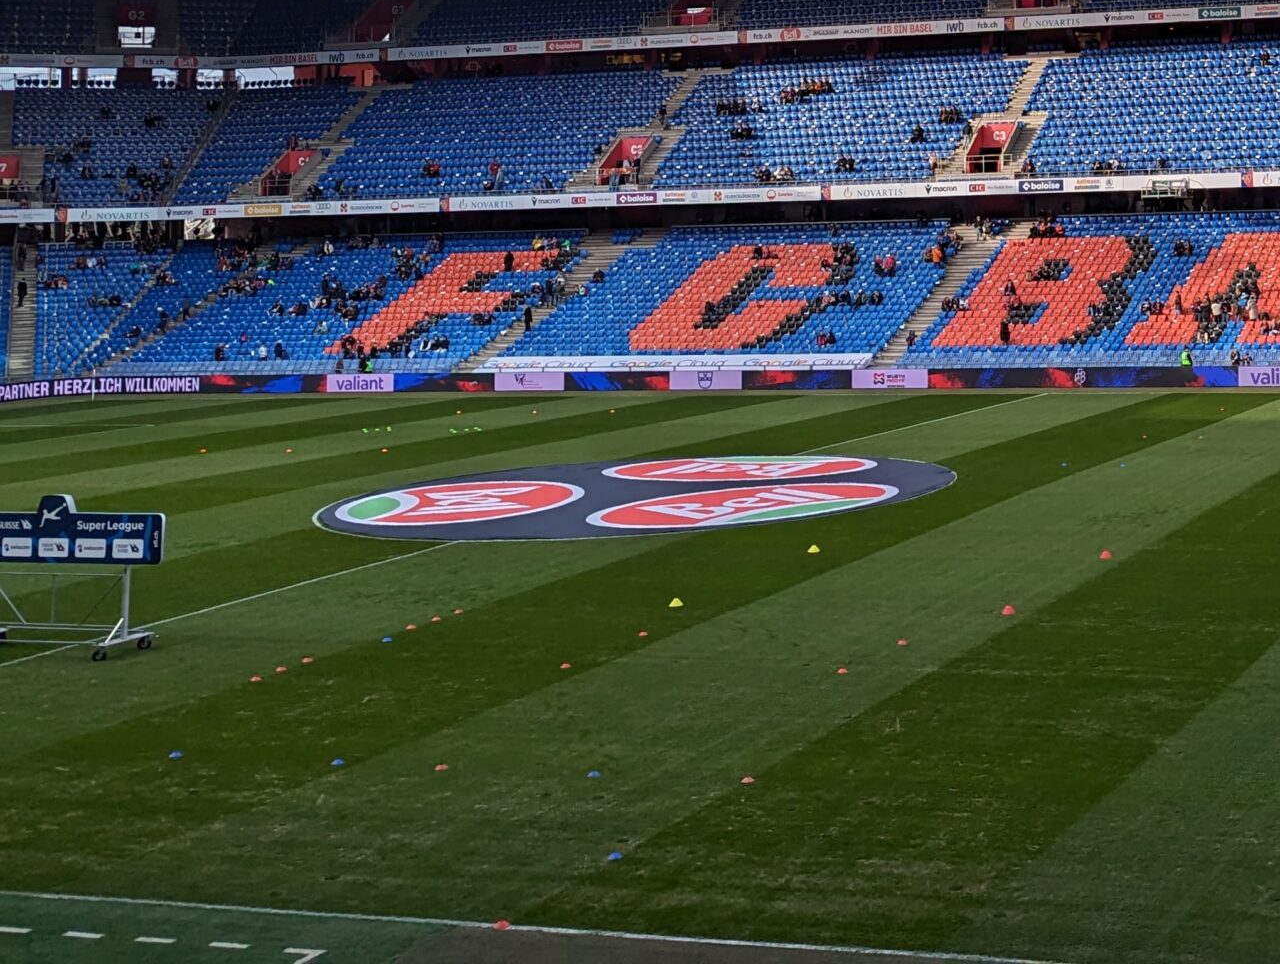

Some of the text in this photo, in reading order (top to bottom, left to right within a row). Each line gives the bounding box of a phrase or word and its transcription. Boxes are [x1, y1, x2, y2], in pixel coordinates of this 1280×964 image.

[128, 10, 145, 20] G2
[1209, 8, 1238, 17] baloise
[1035, 17, 1081, 28] NOVARTIS
[1111, 14, 1135, 22] macron
[877, 23, 933, 35] MIR SIN BASEL
[977, 21, 998, 30] fcb.ch
[752, 32, 772, 40] fcb.ch
[993, 130, 1006, 141] C3
[932, 184, 957, 193] macron
[970, 184, 984, 192] CIC
[1030, 181, 1060, 190] baloise
[856, 187, 904, 197] NOVARTIS
[538, 197, 561, 205] macron
[627, 193, 654, 203] baloise
[471, 200, 514, 209] NOVARTIS
[172, 209, 193, 217] macron
[254, 206, 279, 215] baloise
[96, 211, 150, 221] NOVARTIS
[482, 358, 542, 370] Google
[610, 358, 672, 369] Google
[744, 357, 808, 368] Google
[336, 375, 384, 390] valiant
[0, 377, 200, 401] PARTNER HERZLICH WILLKOMMEN
[636, 487, 845, 519] Bell
[76, 520, 144, 534] Super League
